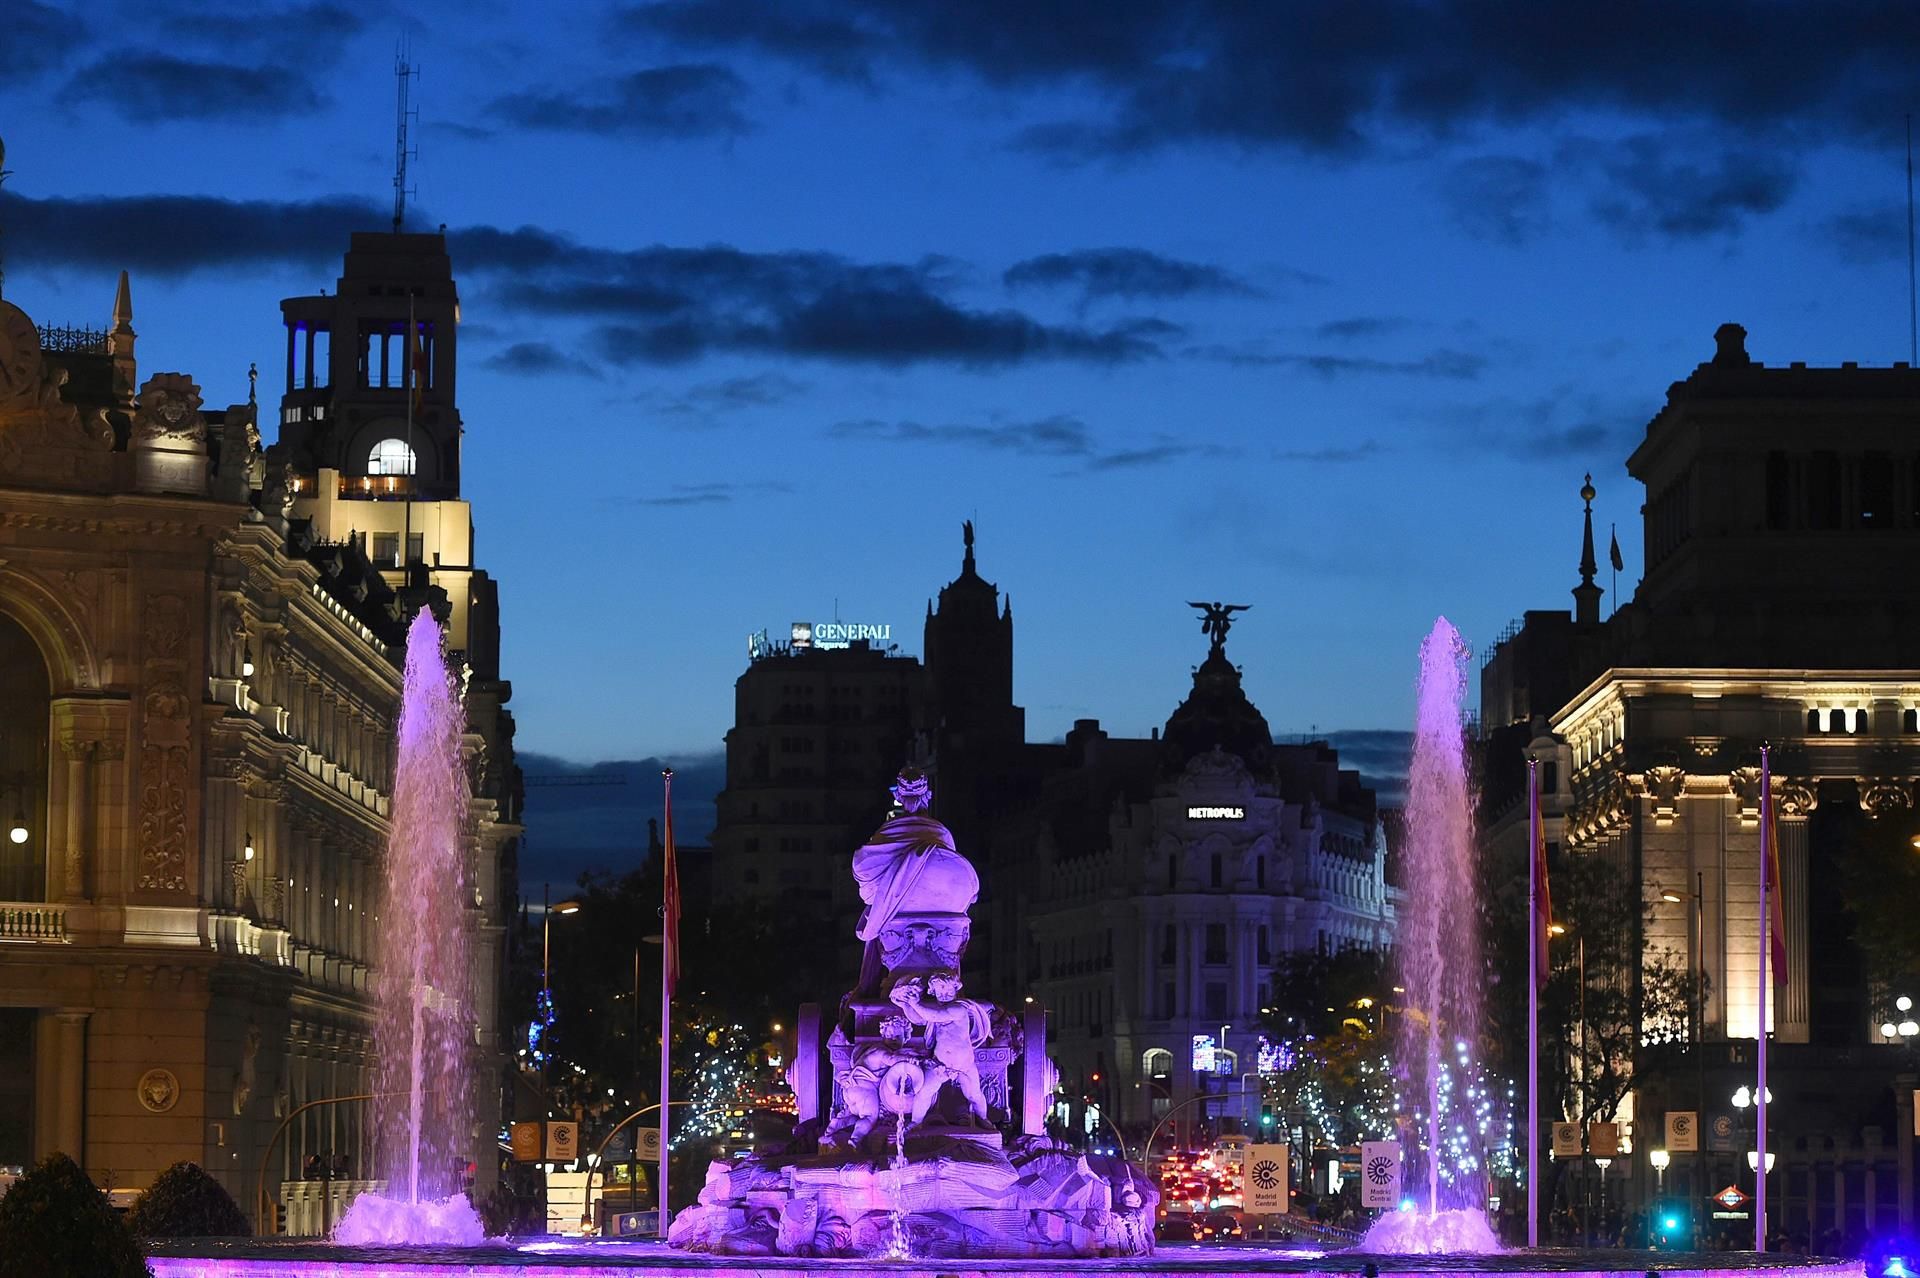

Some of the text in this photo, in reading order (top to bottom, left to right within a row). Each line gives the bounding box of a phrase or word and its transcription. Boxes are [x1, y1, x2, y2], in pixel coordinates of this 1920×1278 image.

[815, 624, 890, 639] GENERALI
[815, 639, 849, 650] Seguros
[1188, 807, 1244, 818] METROPOLIS
